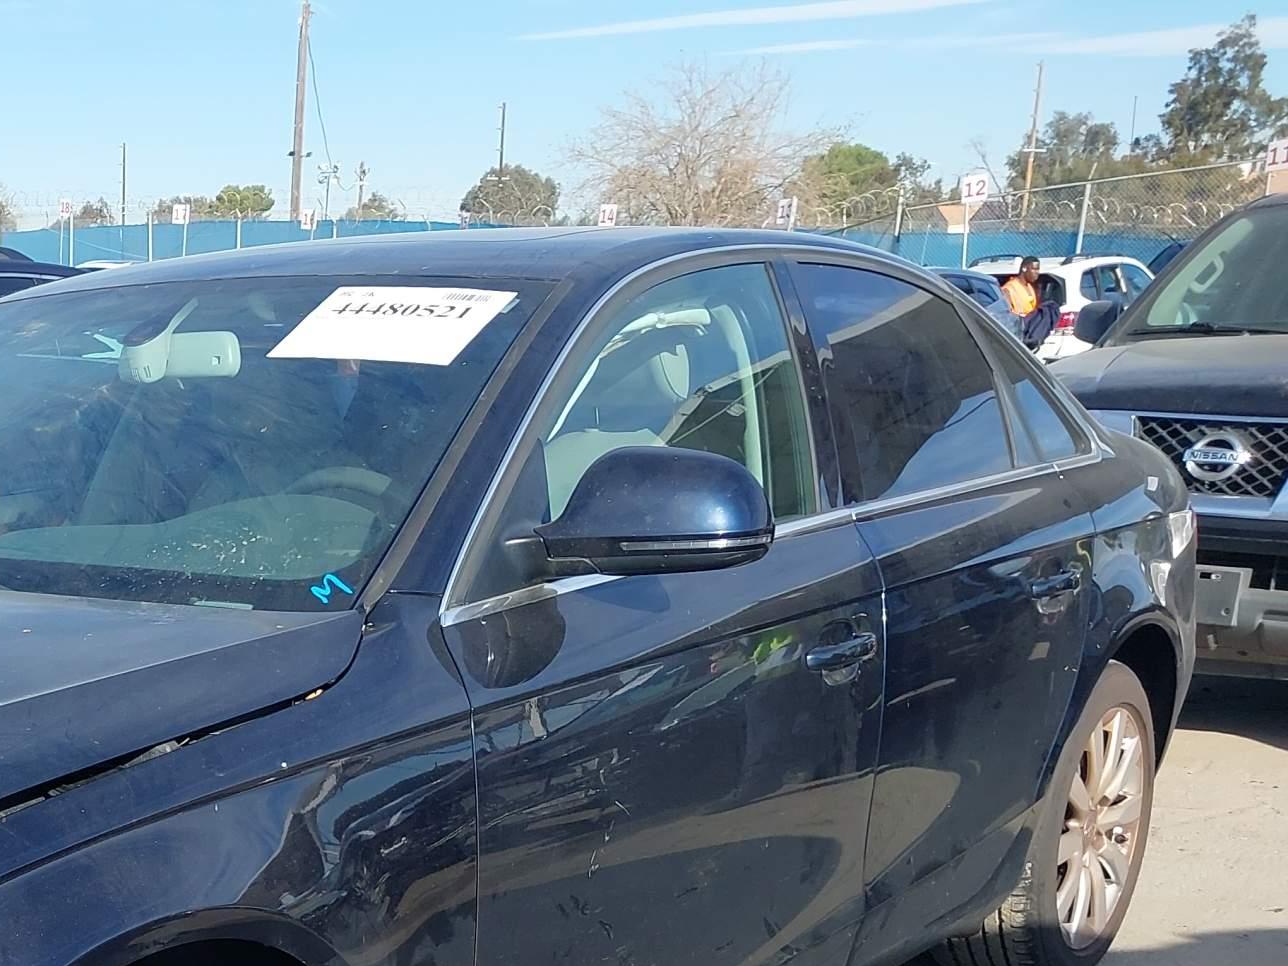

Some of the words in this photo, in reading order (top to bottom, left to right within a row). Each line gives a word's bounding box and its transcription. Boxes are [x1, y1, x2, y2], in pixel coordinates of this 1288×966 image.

[964, 179, 986, 198] 12
[60, 201, 70, 214] 18
[599, 208, 615, 224] 14
[331, 302, 473, 319] 44480521
[1190, 449, 1239, 462] NISSAN
